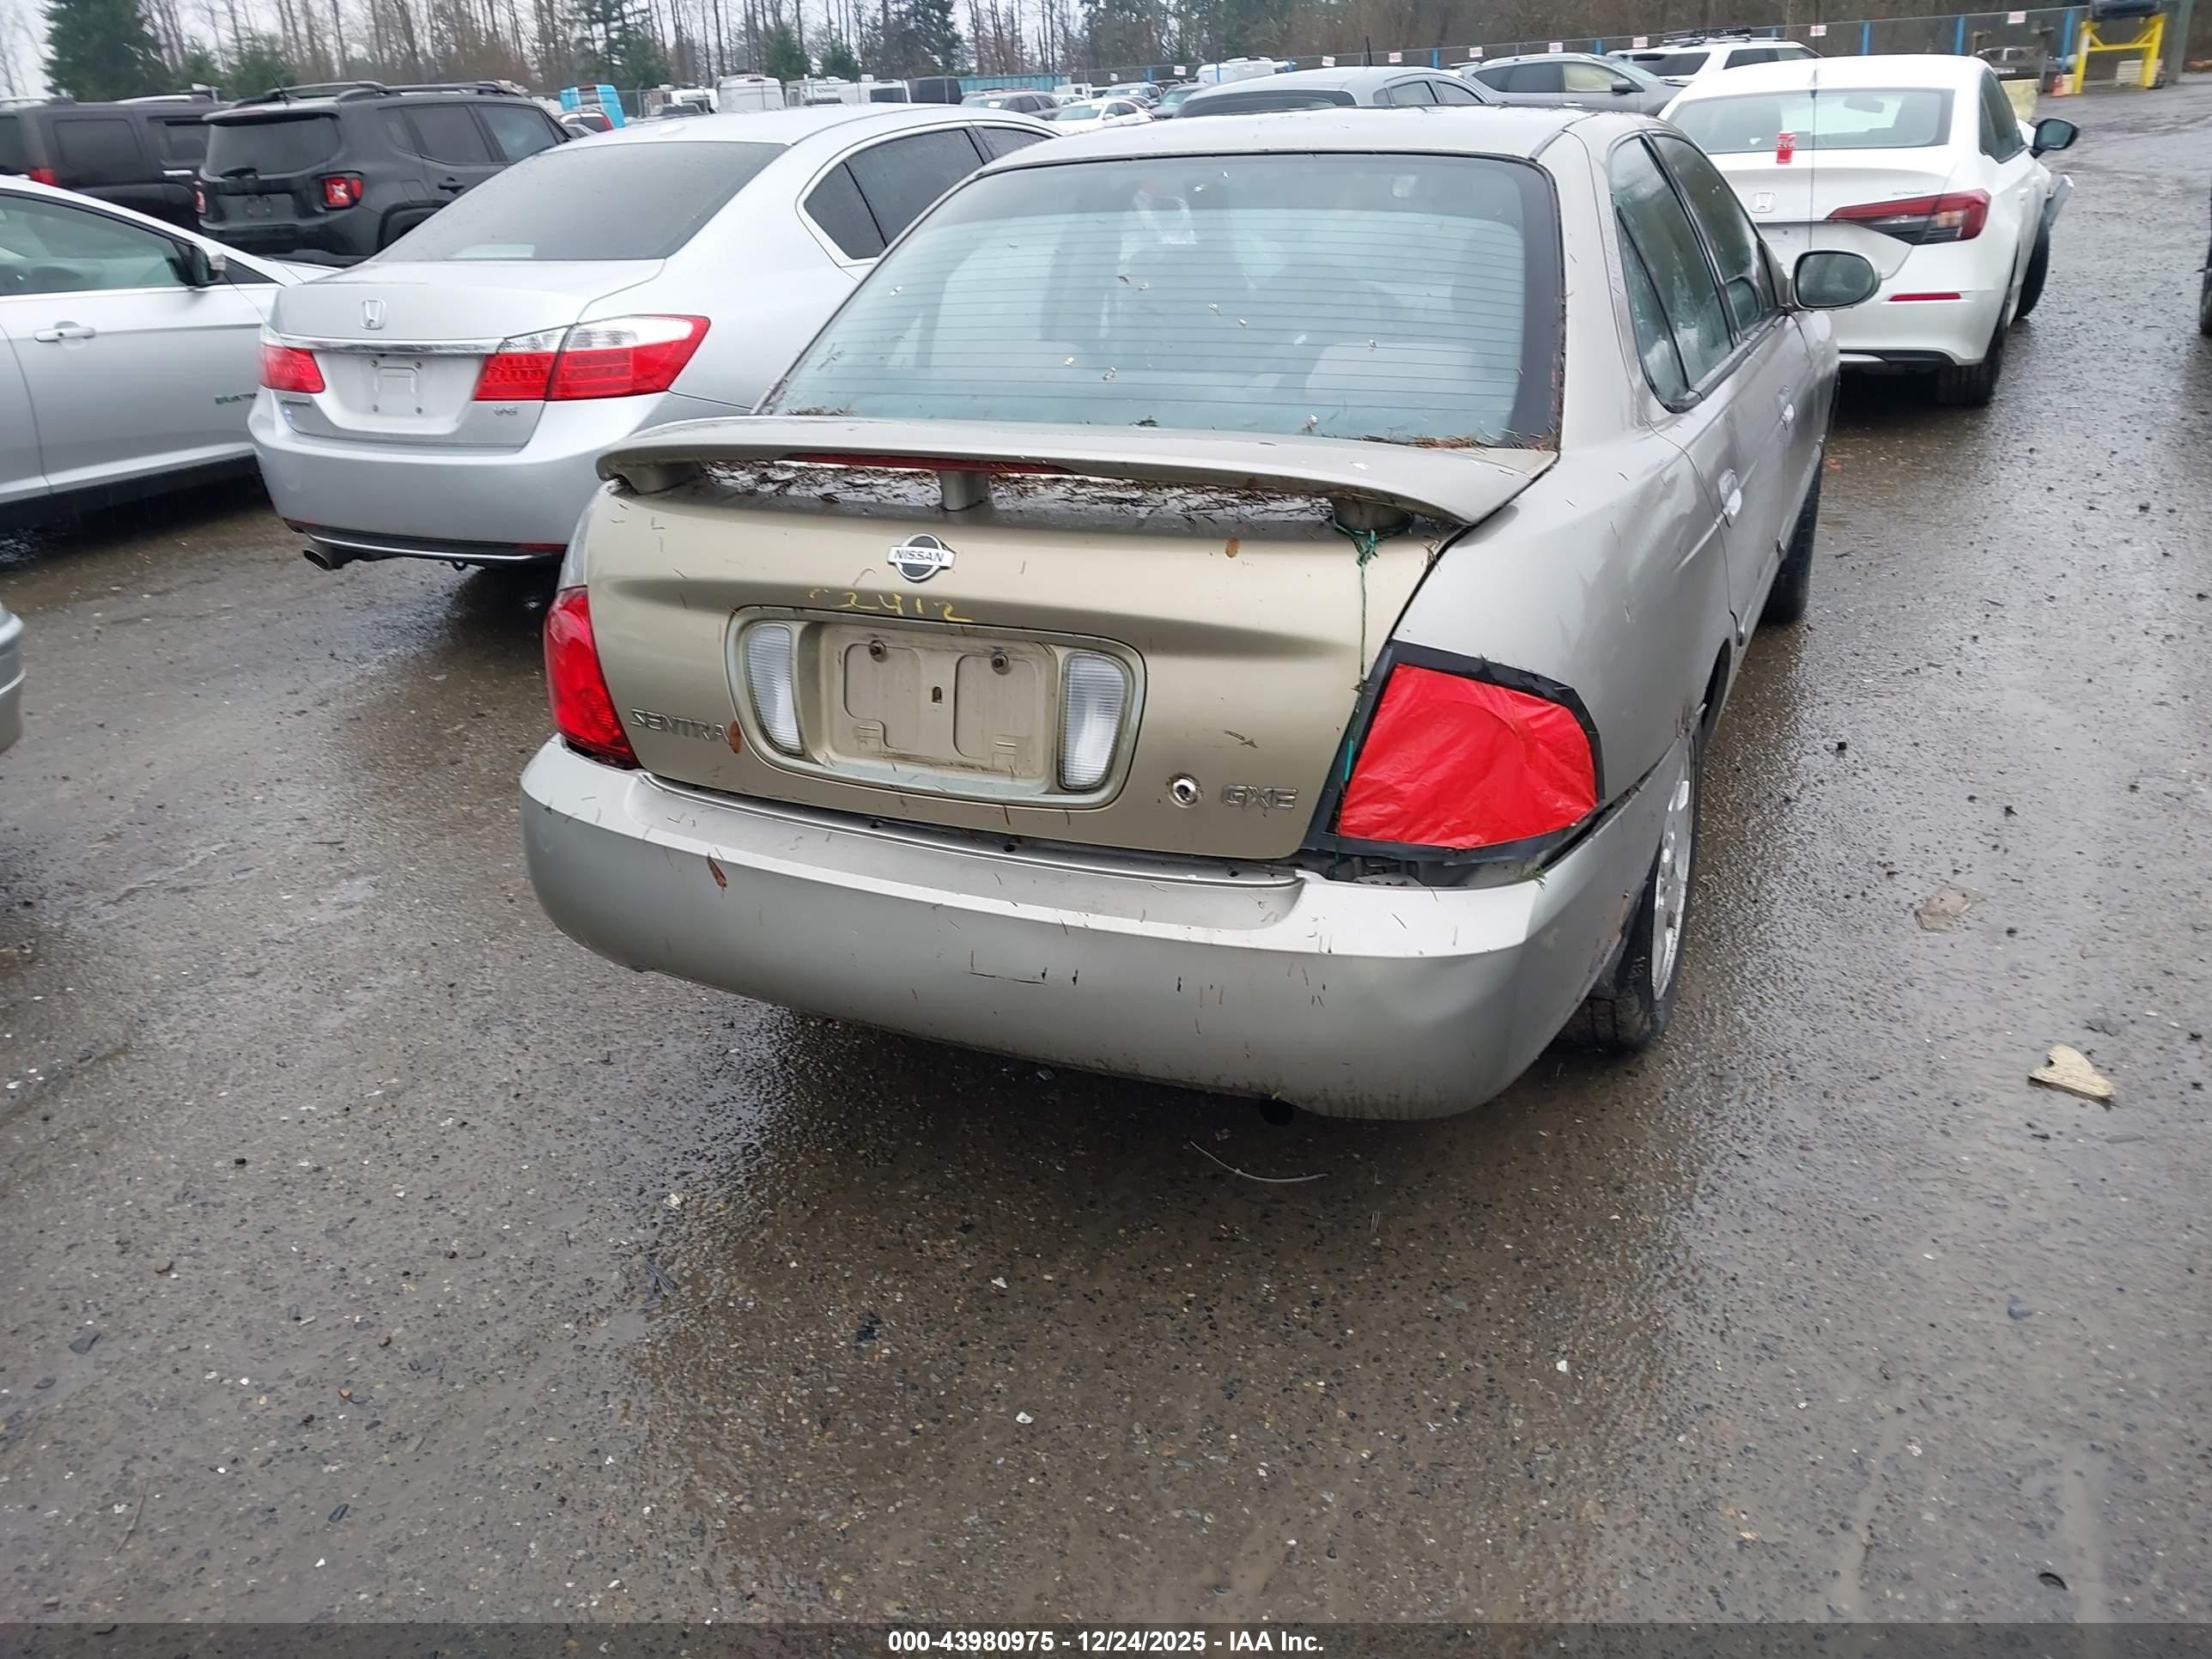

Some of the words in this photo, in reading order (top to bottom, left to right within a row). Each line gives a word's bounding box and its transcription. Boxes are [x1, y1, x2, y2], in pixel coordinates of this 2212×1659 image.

[893, 549, 945, 562] NISSAN
[630, 708, 731, 742] SENTRA
[1222, 783, 1297, 810] GXE
